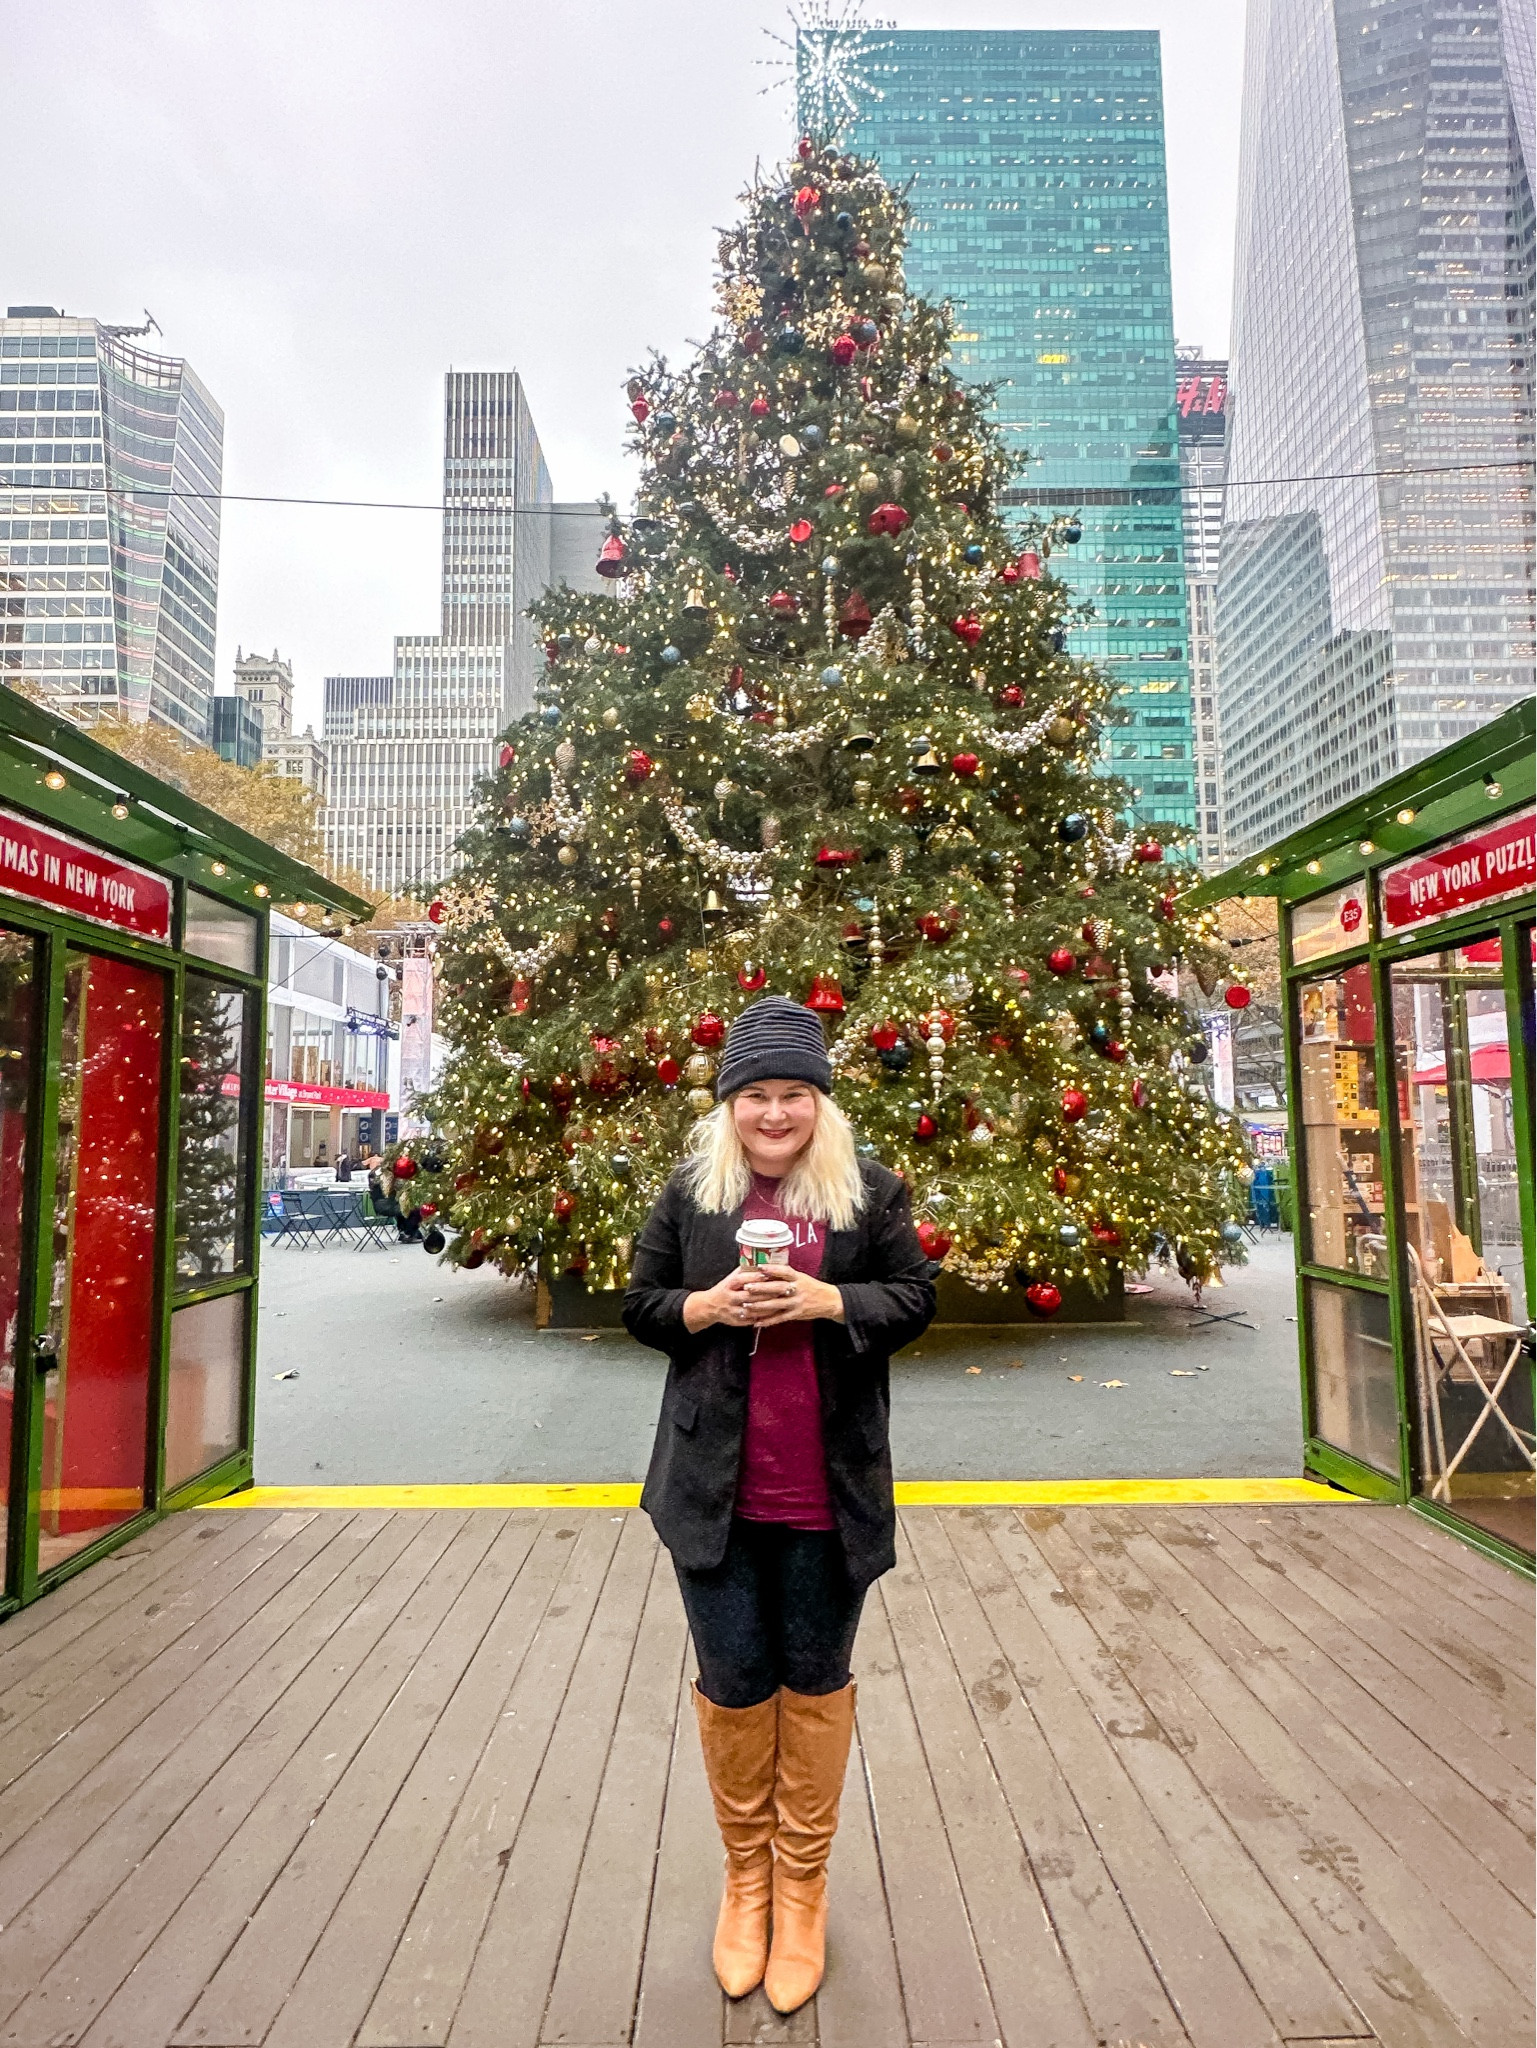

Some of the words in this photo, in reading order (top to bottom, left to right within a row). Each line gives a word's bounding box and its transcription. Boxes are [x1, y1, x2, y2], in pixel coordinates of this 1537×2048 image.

[44, 853, 60, 885] IN
[65, 862, 97, 898] NEW
[102, 876, 135, 912] YORK
[1410, 872, 1439, 905] NEW
[1442, 856, 1481, 893] YORK
[1485, 833, 1536, 878] PUZZL
[1343, 908, 1359, 922] E35
